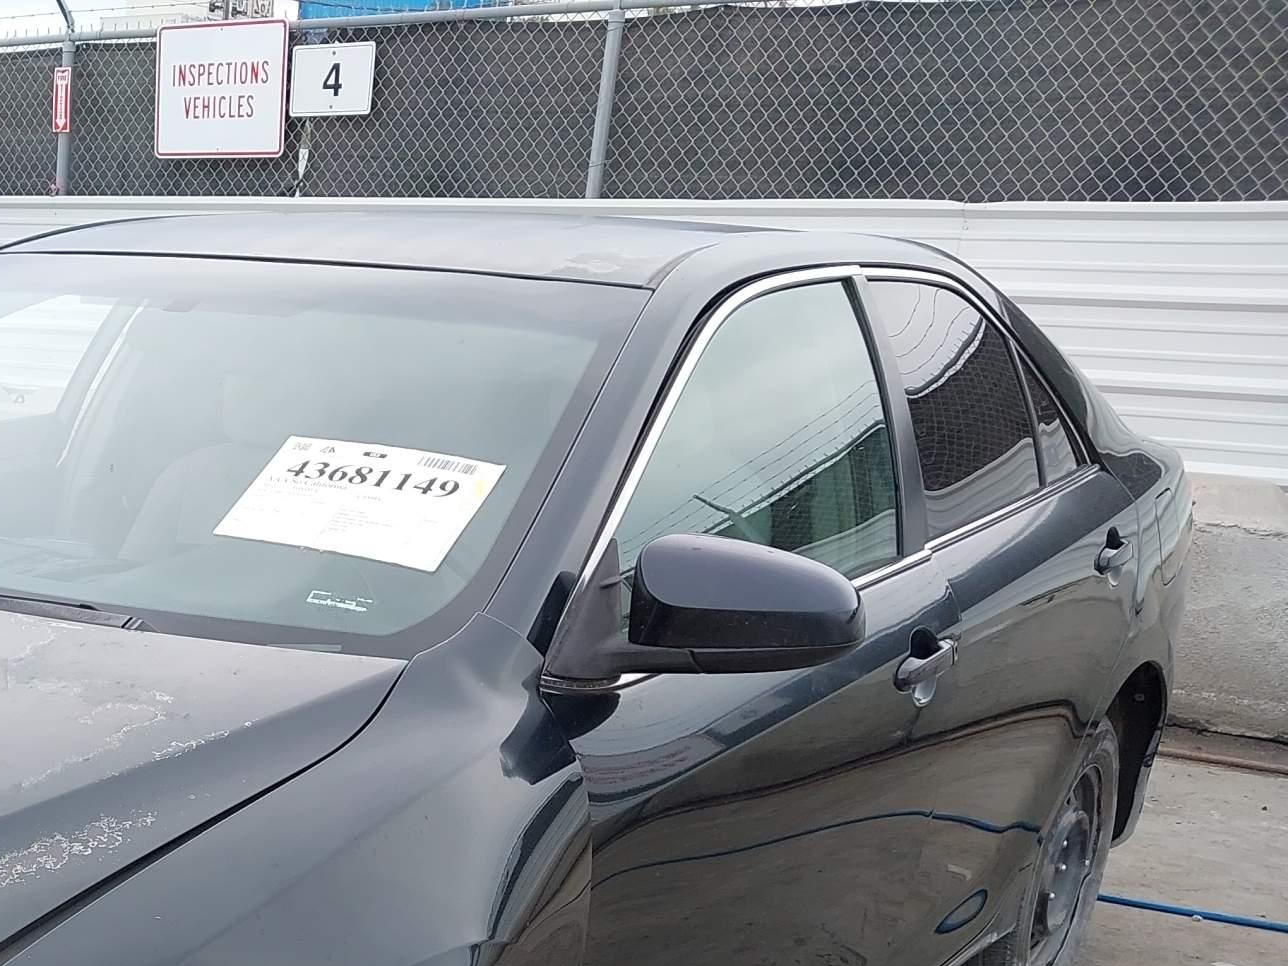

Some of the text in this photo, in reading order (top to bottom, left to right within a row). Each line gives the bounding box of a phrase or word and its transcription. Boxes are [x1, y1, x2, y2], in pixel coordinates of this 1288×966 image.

[171, 60, 270, 87] INSPECTIONS
[322, 62, 343, 97] 4
[183, 95, 255, 120] VEHICLES
[285, 459, 460, 499] 43681149
